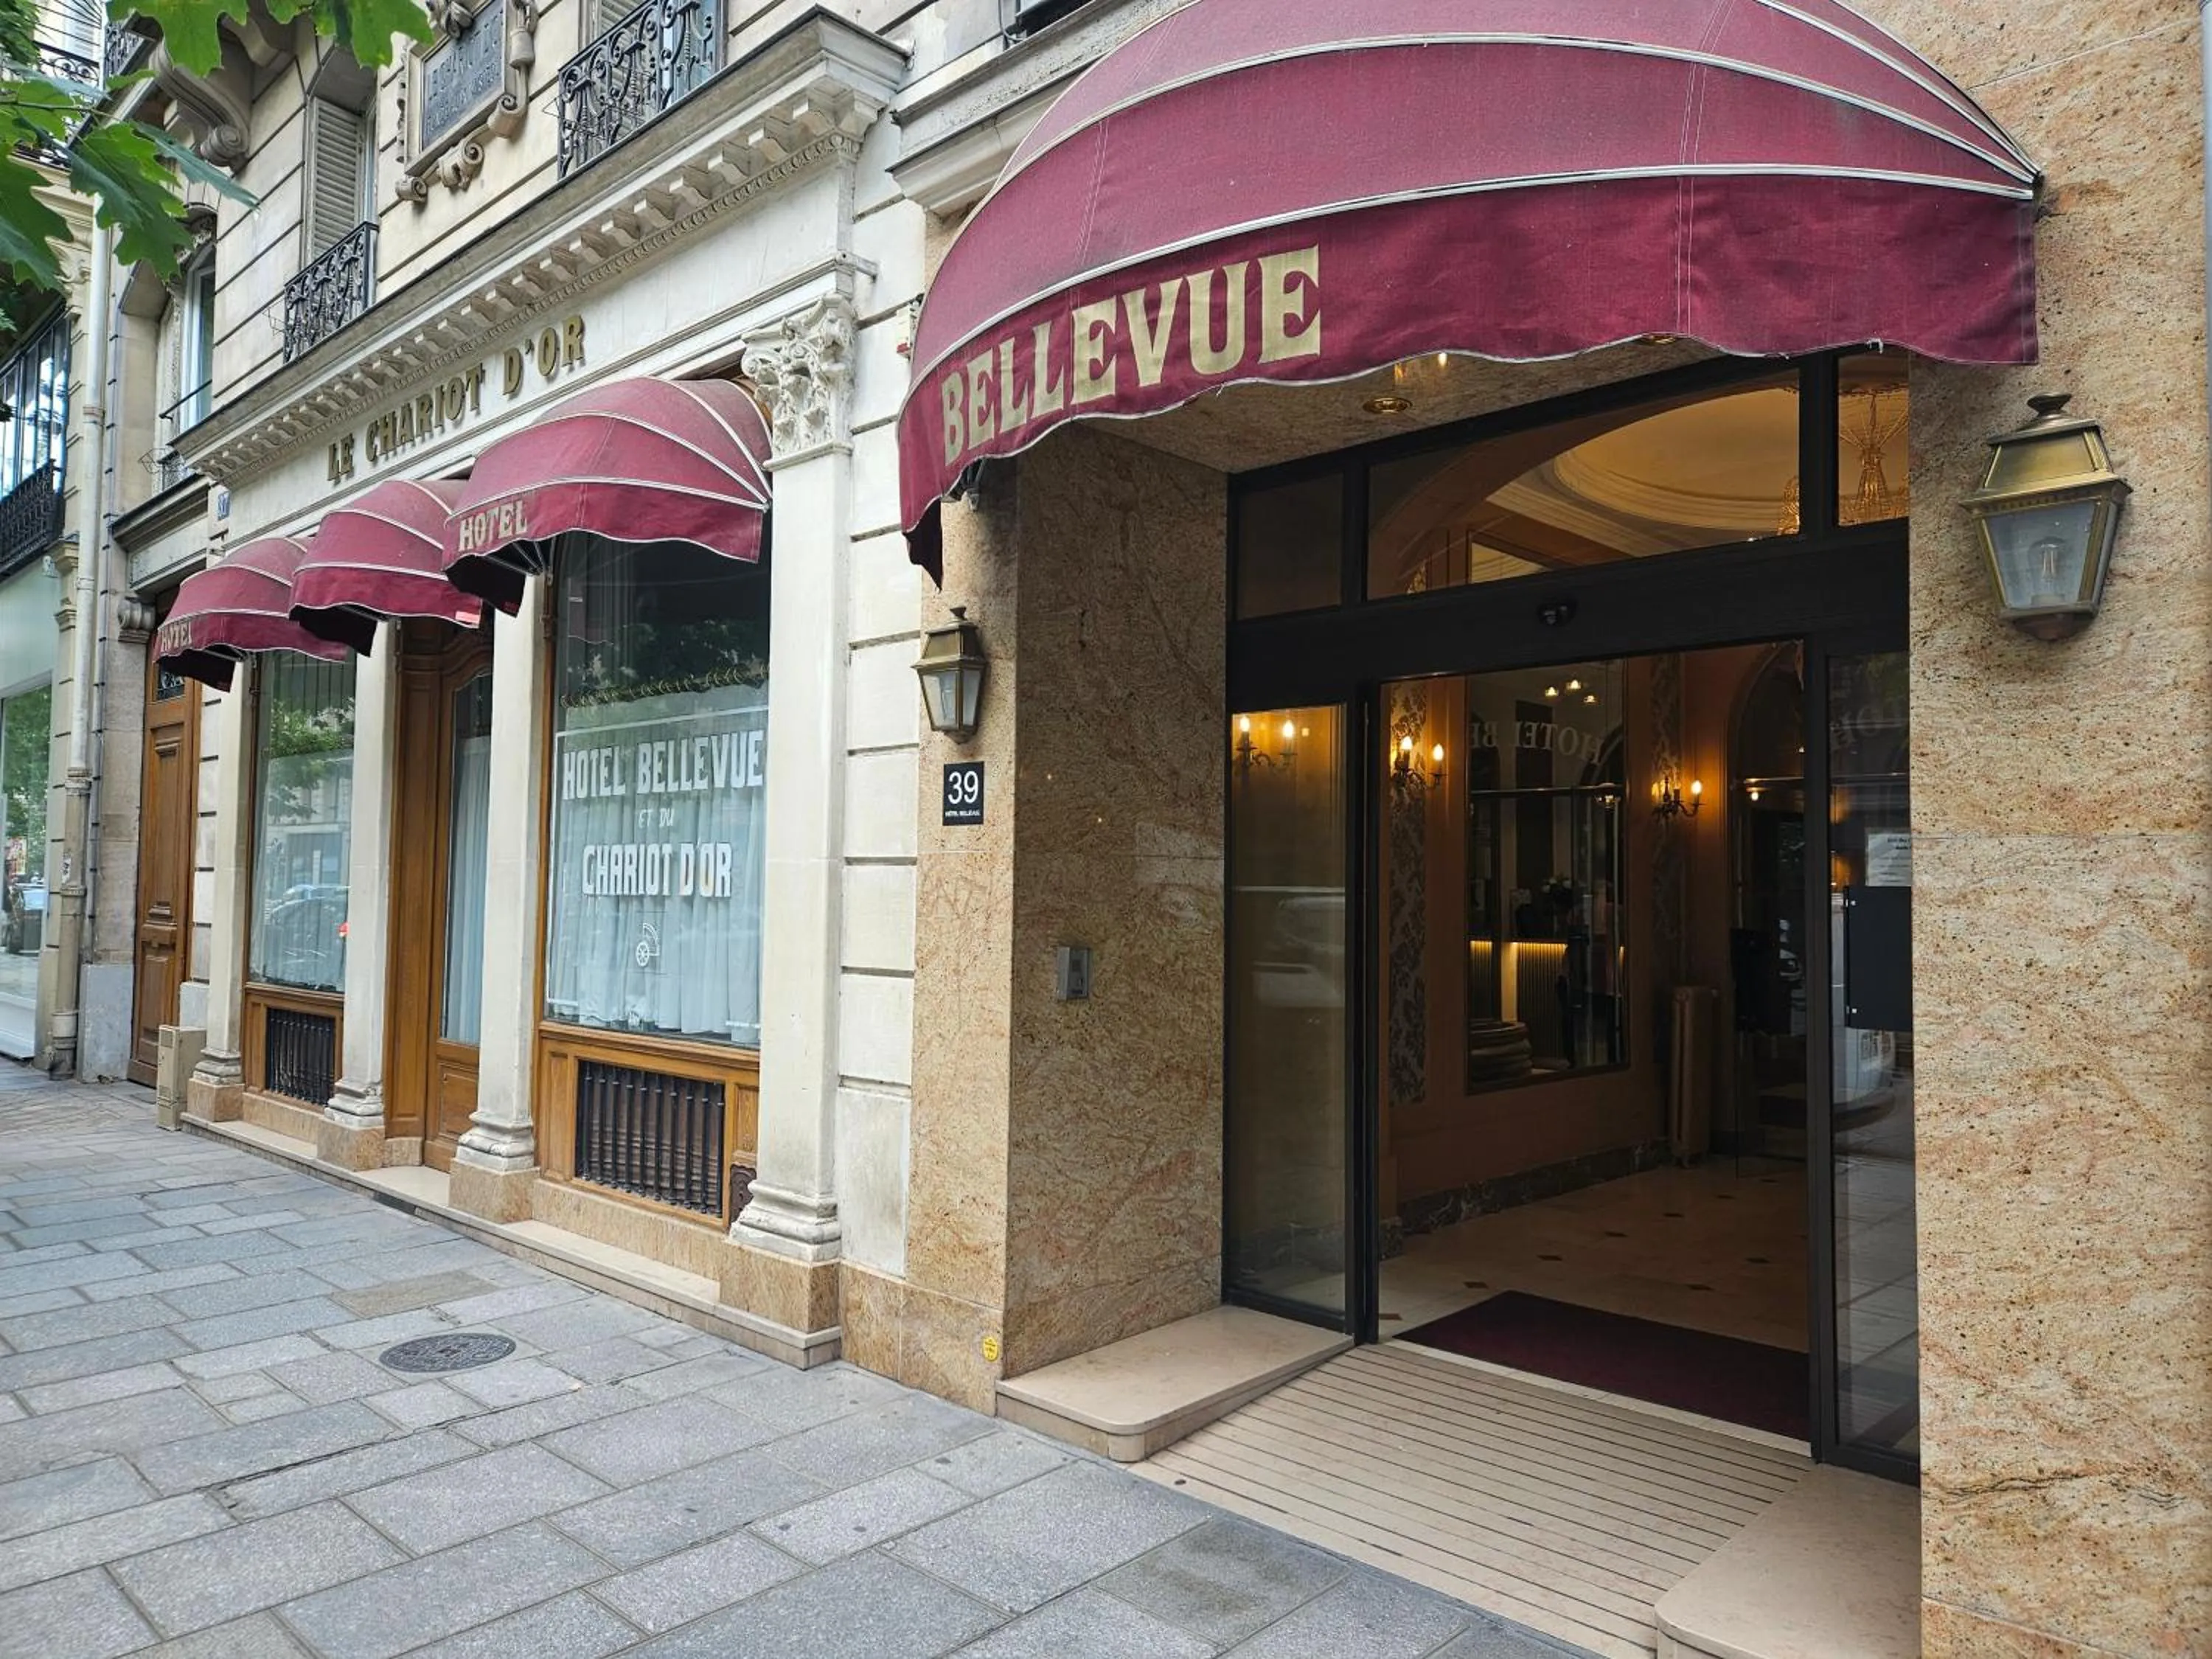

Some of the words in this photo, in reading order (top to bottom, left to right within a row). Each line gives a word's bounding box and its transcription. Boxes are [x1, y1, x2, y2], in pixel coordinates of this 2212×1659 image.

[941, 244, 1321, 466] BELLEVUE
[327, 434, 354, 481] LE
[366, 364, 486, 462] CHARIOT
[503, 314, 585, 396] D'OR
[458, 500, 527, 552] HOTEL
[563, 746, 626, 800] HOTEL
[636, 730, 764, 794] BELLEVUE
[947, 771, 978, 804] 39
[639, 809, 653, 828] ET
[659, 808, 675, 827] DU
[582, 843, 672, 897] CHARIOT
[679, 838, 732, 898] D'OR
